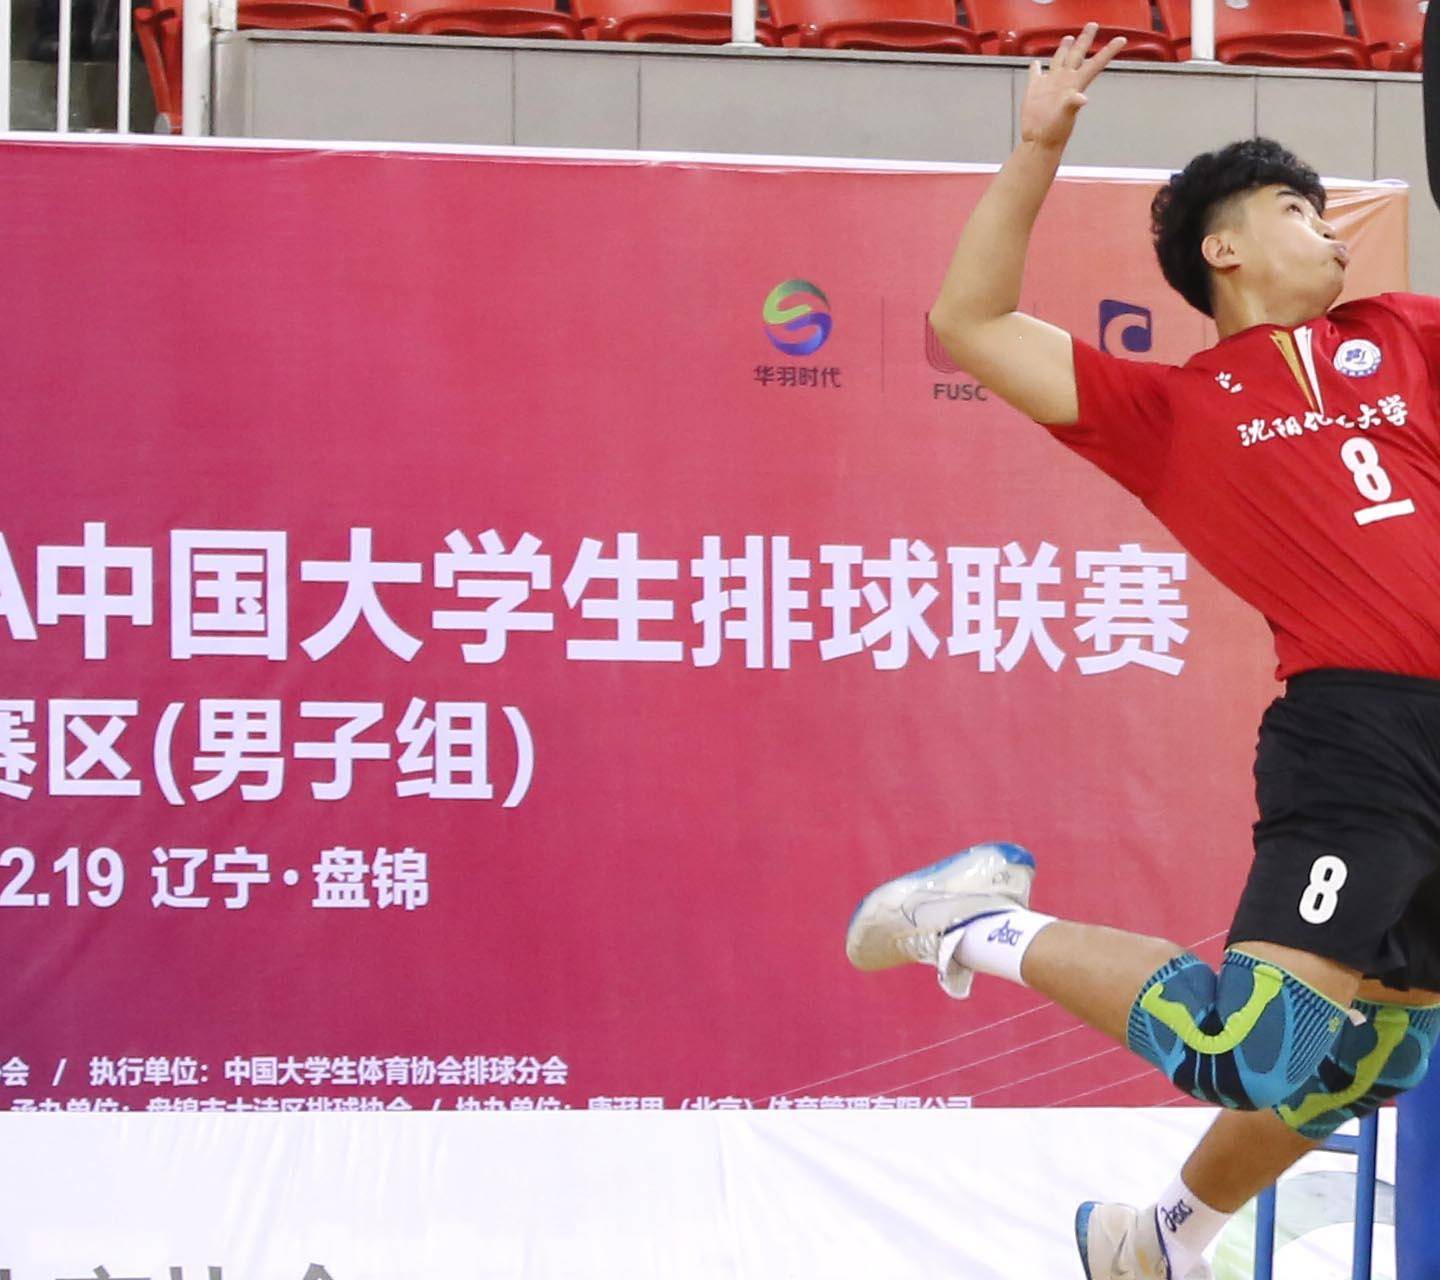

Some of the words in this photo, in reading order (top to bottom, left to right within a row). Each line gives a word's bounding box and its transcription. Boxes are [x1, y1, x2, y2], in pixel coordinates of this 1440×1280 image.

[753, 364, 842, 390] 华羽时代
[933, 383, 988, 402] FUSC
[1340, 436, 1392, 502] 8
[150, 846, 429, 911] 辽宁·盘锦
[1298, 854, 1348, 925] 8
